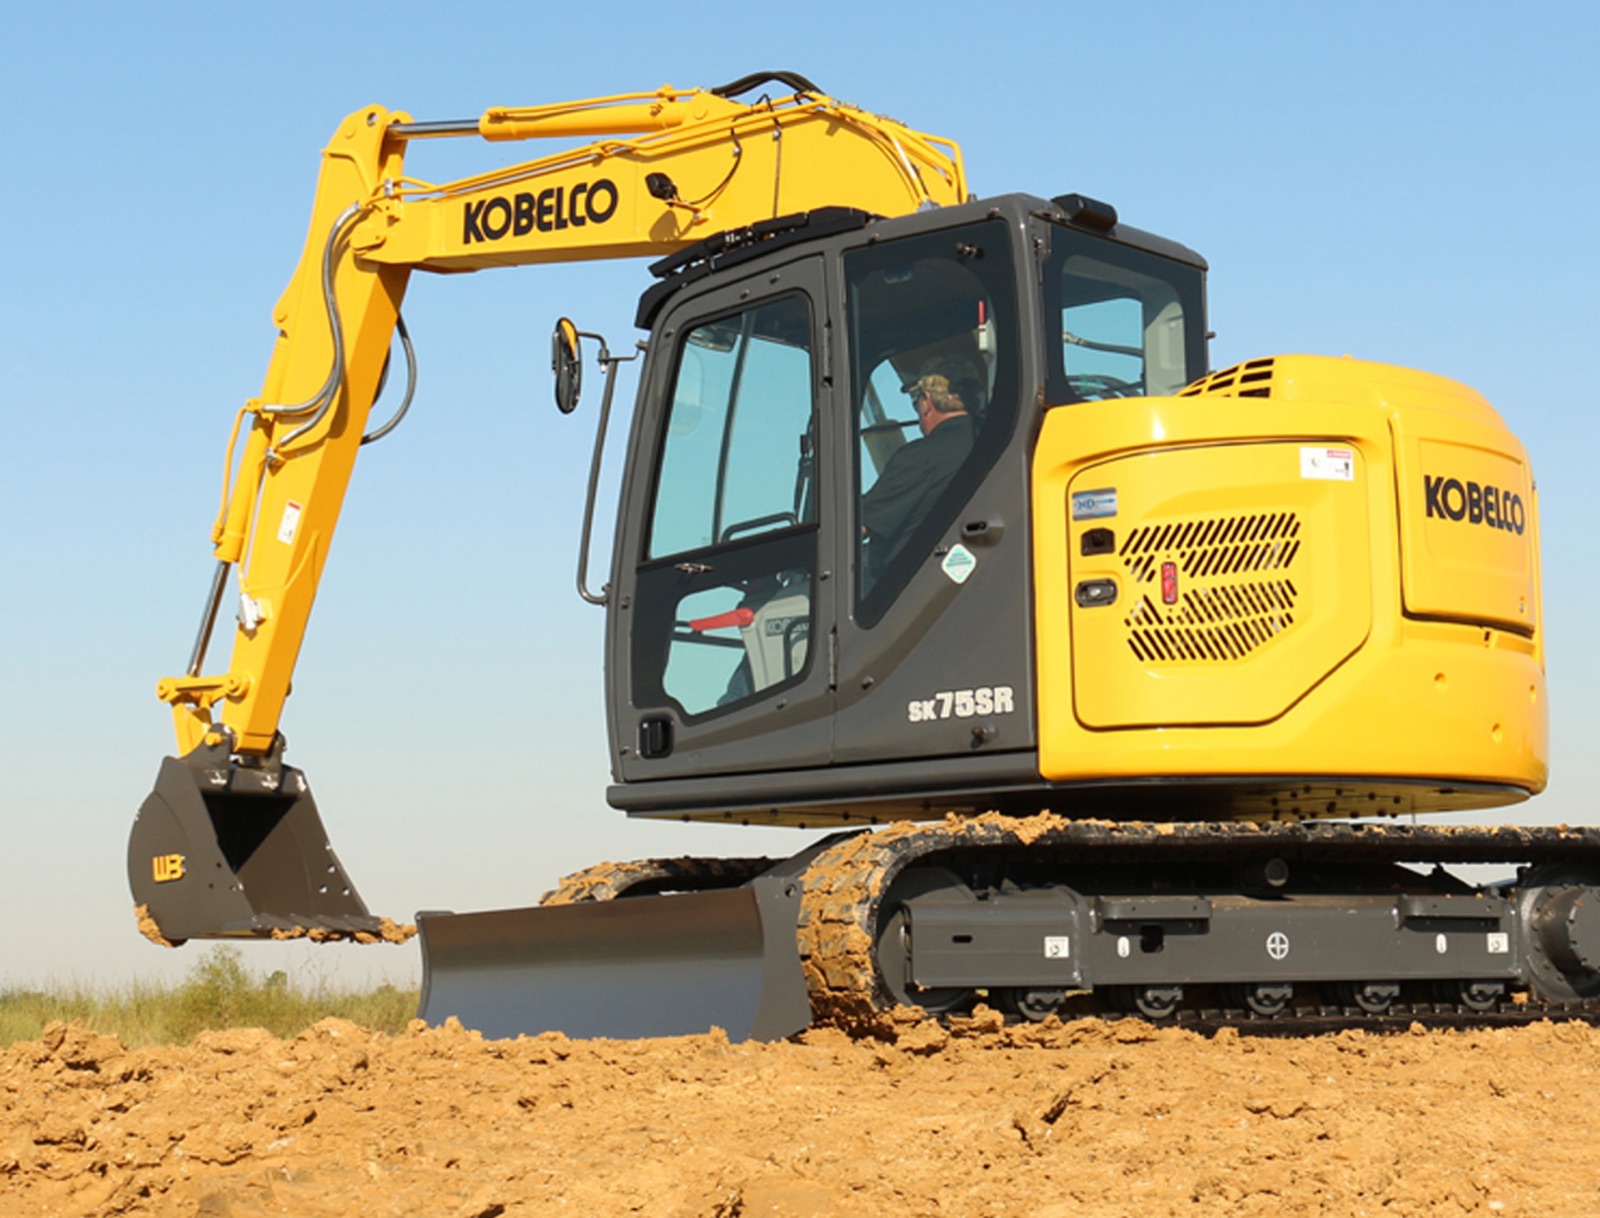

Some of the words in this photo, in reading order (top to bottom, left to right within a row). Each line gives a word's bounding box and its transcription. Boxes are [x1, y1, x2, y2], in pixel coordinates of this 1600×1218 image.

[463, 179, 618, 245] KOBELCO
[1424, 474, 1525, 536] KOBELCO
[908, 686, 1014, 722] SK75SR
